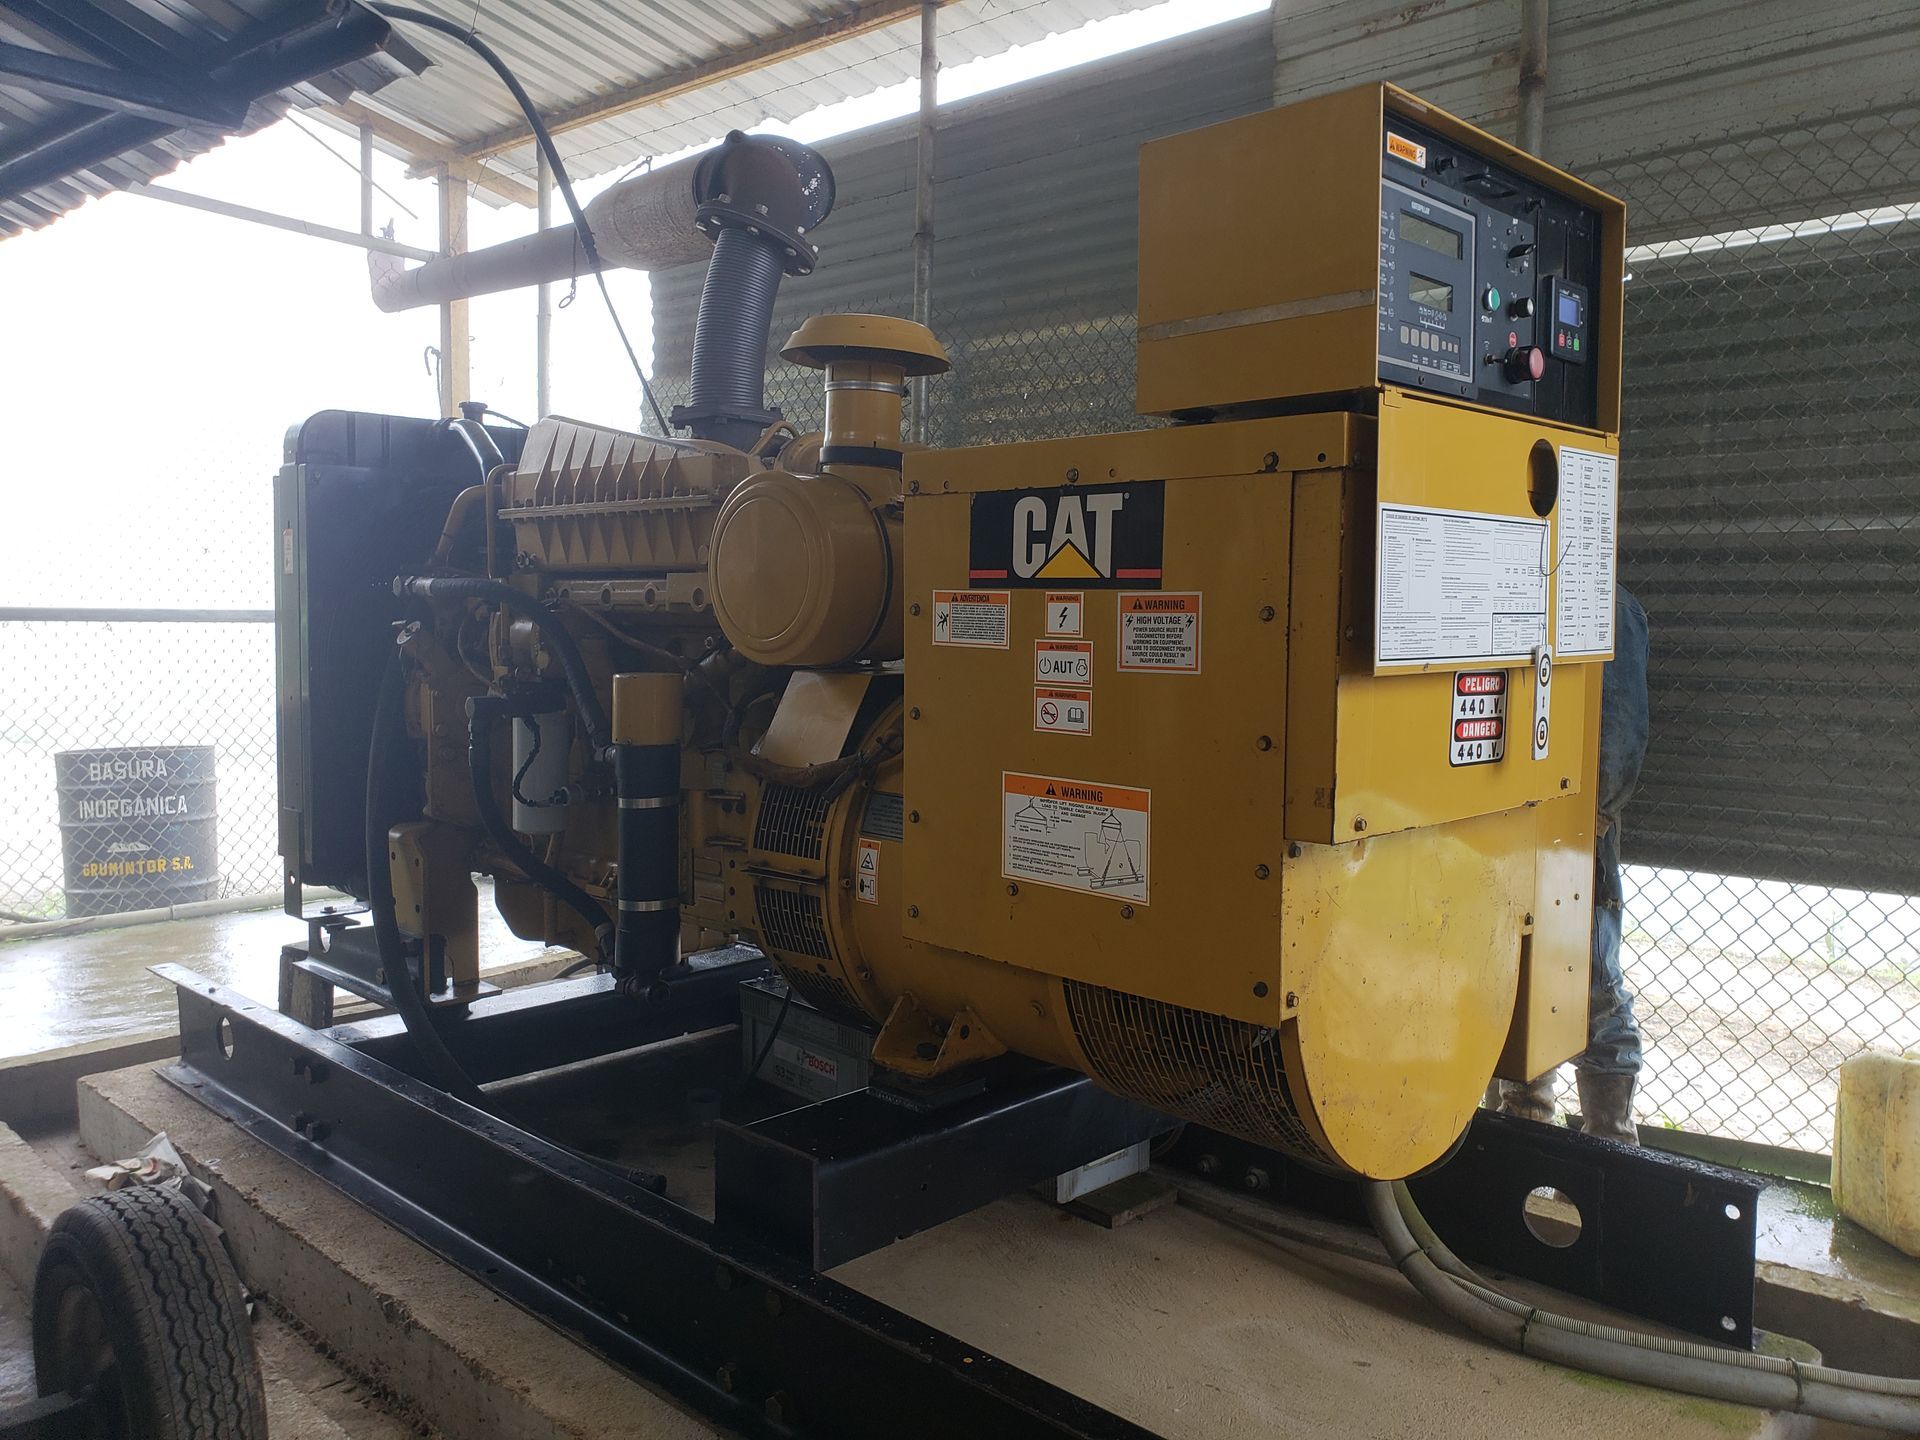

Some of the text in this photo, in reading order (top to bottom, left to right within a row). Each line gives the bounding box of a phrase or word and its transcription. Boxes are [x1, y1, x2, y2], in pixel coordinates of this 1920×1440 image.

[1012, 493, 1123, 578] CAT
[1145, 600, 1185, 610] WARNING
[1136, 616, 1181, 624] HIGH VOLTAGE
[1053, 660, 1073, 673] AUT
[1465, 677, 1500, 691] PELIGRO
[1461, 698, 1484, 715] 440
[1463, 722, 1496, 737] DANGER
[1458, 743, 1482, 760] 440
[90, 759, 167, 780] BASURA
[1061, 786, 1103, 802] WARNING
[80, 795, 188, 819] INORGANICA
[83, 856, 194, 877] GRUMINTOR S.A.
[809, 1056, 835, 1076] BOSCH
